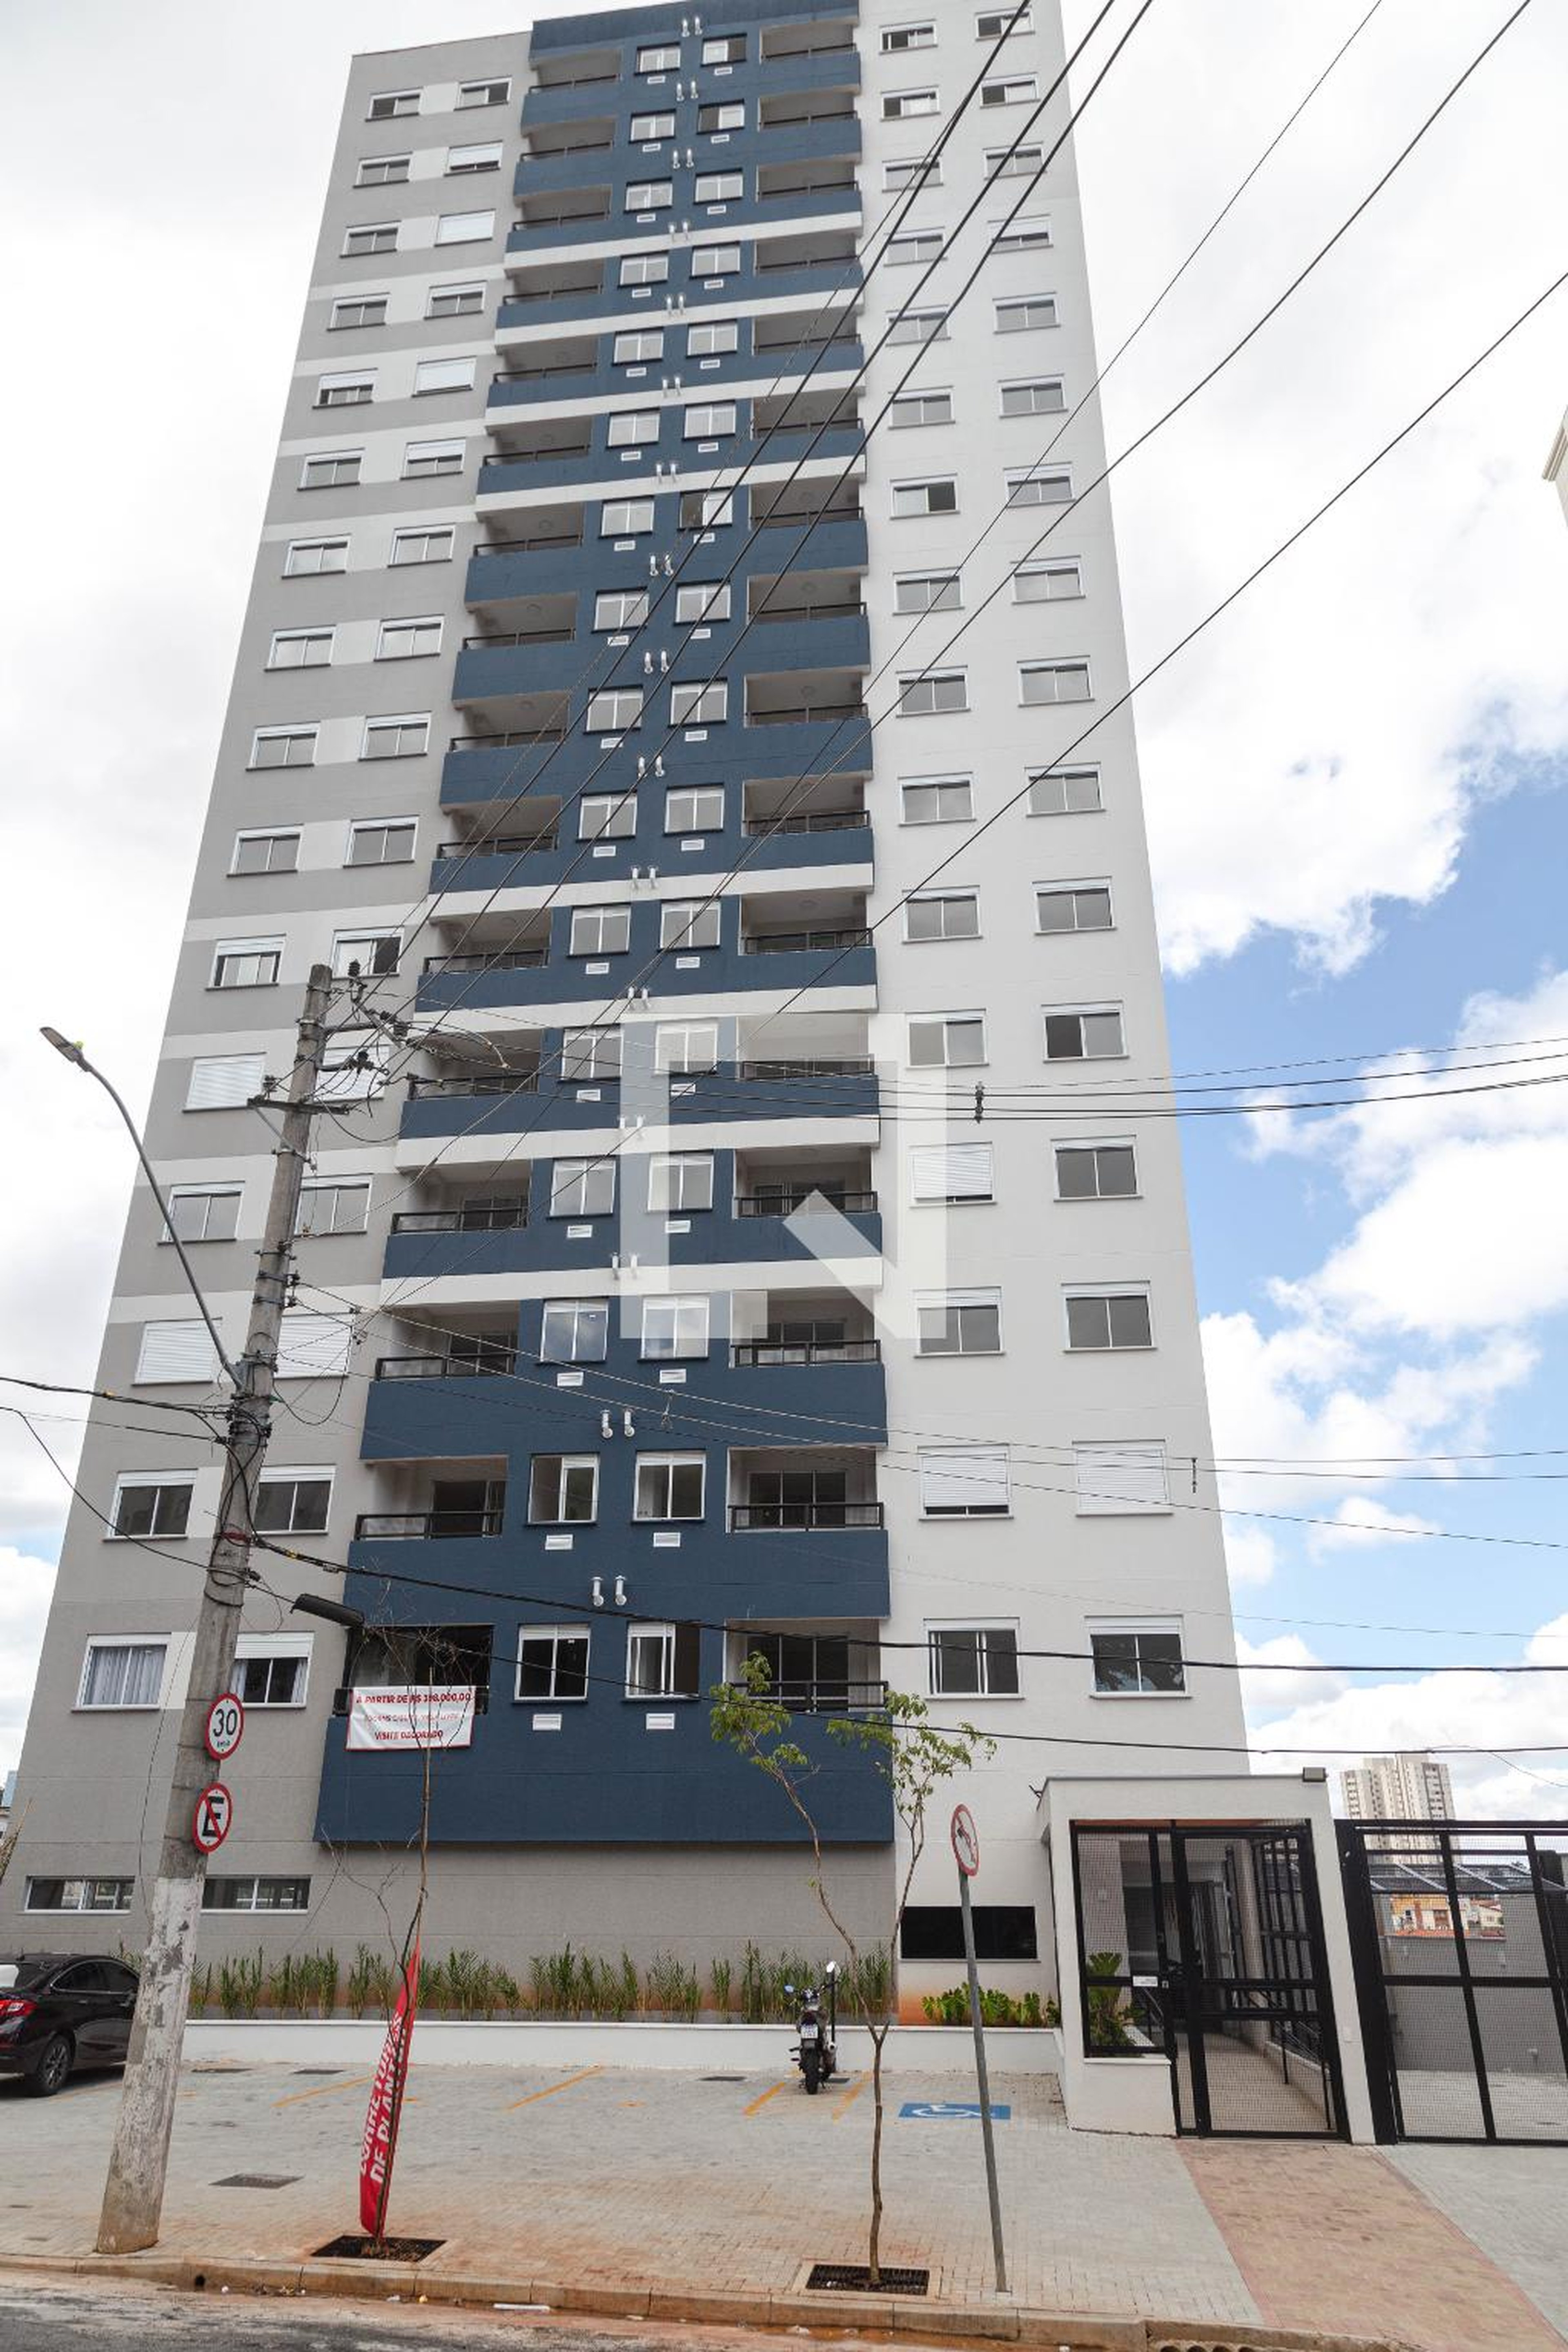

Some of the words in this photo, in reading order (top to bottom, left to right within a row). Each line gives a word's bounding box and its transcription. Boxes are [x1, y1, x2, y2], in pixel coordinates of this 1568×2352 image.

[365, 1695, 395, 1704] PARTIR
[396, 1695, 408, 1703] DE
[213, 1708, 237, 1737] 30
[375, 1731, 399, 1740] VISITE
